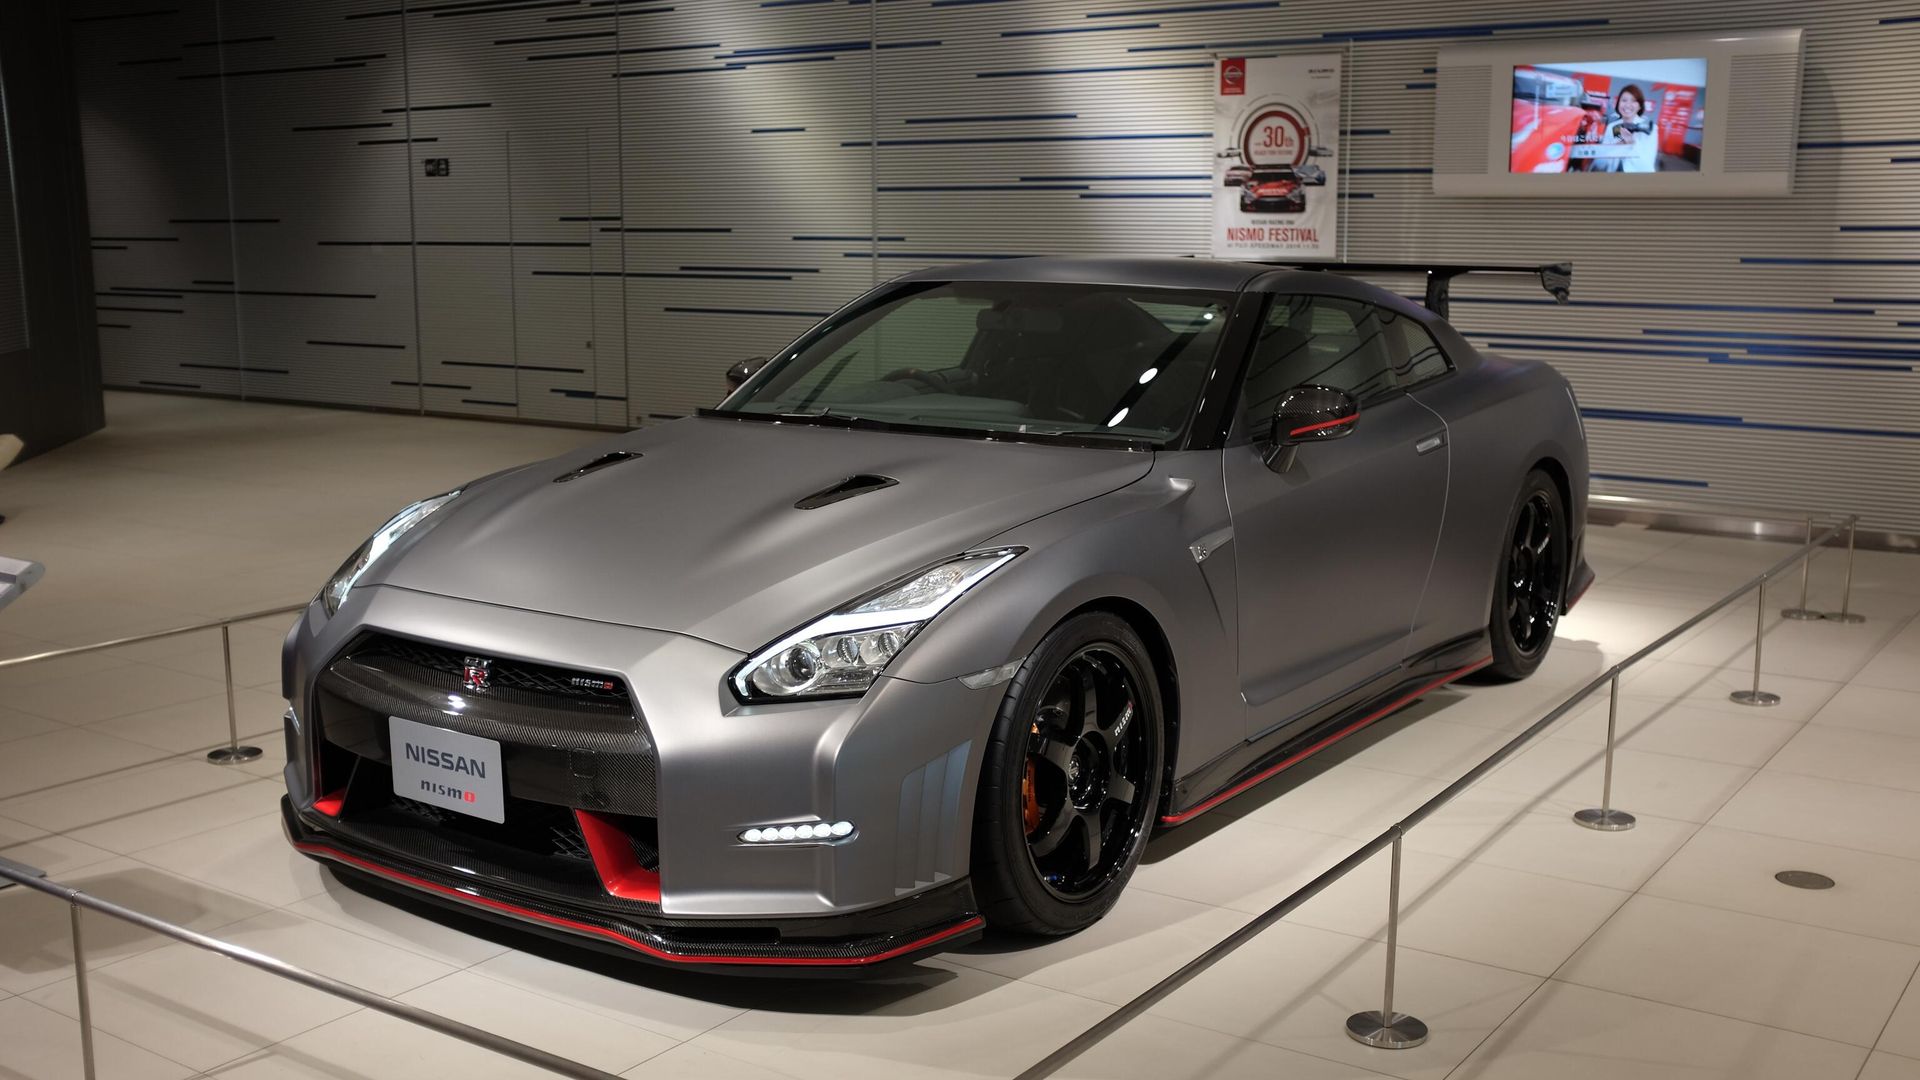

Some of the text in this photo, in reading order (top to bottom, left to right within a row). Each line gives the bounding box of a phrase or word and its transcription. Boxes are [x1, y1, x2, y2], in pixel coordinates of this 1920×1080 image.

[1227, 227, 1319, 242] NISMO FESTIVAL
[405, 742, 486, 779] NISSAN
[420, 780, 476, 803] nismo
